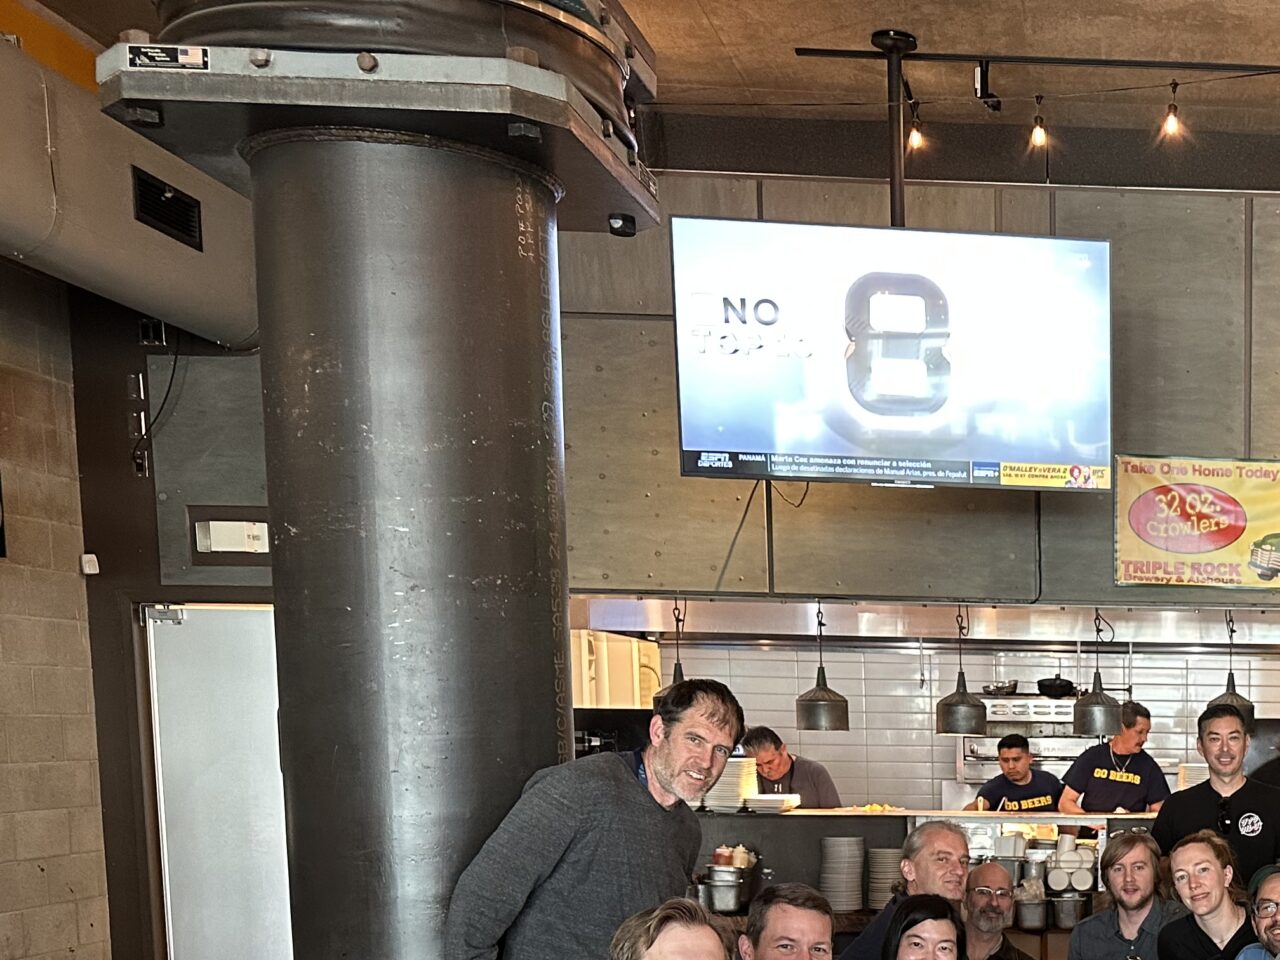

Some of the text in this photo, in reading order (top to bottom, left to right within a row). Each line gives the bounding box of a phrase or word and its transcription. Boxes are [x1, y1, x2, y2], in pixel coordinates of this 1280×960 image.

[722, 297, 780, 326] NO
[845, 271, 951, 417] 8
[1121, 461, 1154, 475] Take
[1160, 463, 1188, 477] One
[1192, 464, 1233, 478] Home
[1155, 491, 1182, 518] 32
[1121, 560, 1242, 578] TRIPLE ROCK
[1123, 574, 1173, 585] Brewery
[1186, 575, 1243, 585] Alehouse
[1094, 768, 1141, 785] GO BEERS
[1005, 795, 1053, 810] GO BEERS
